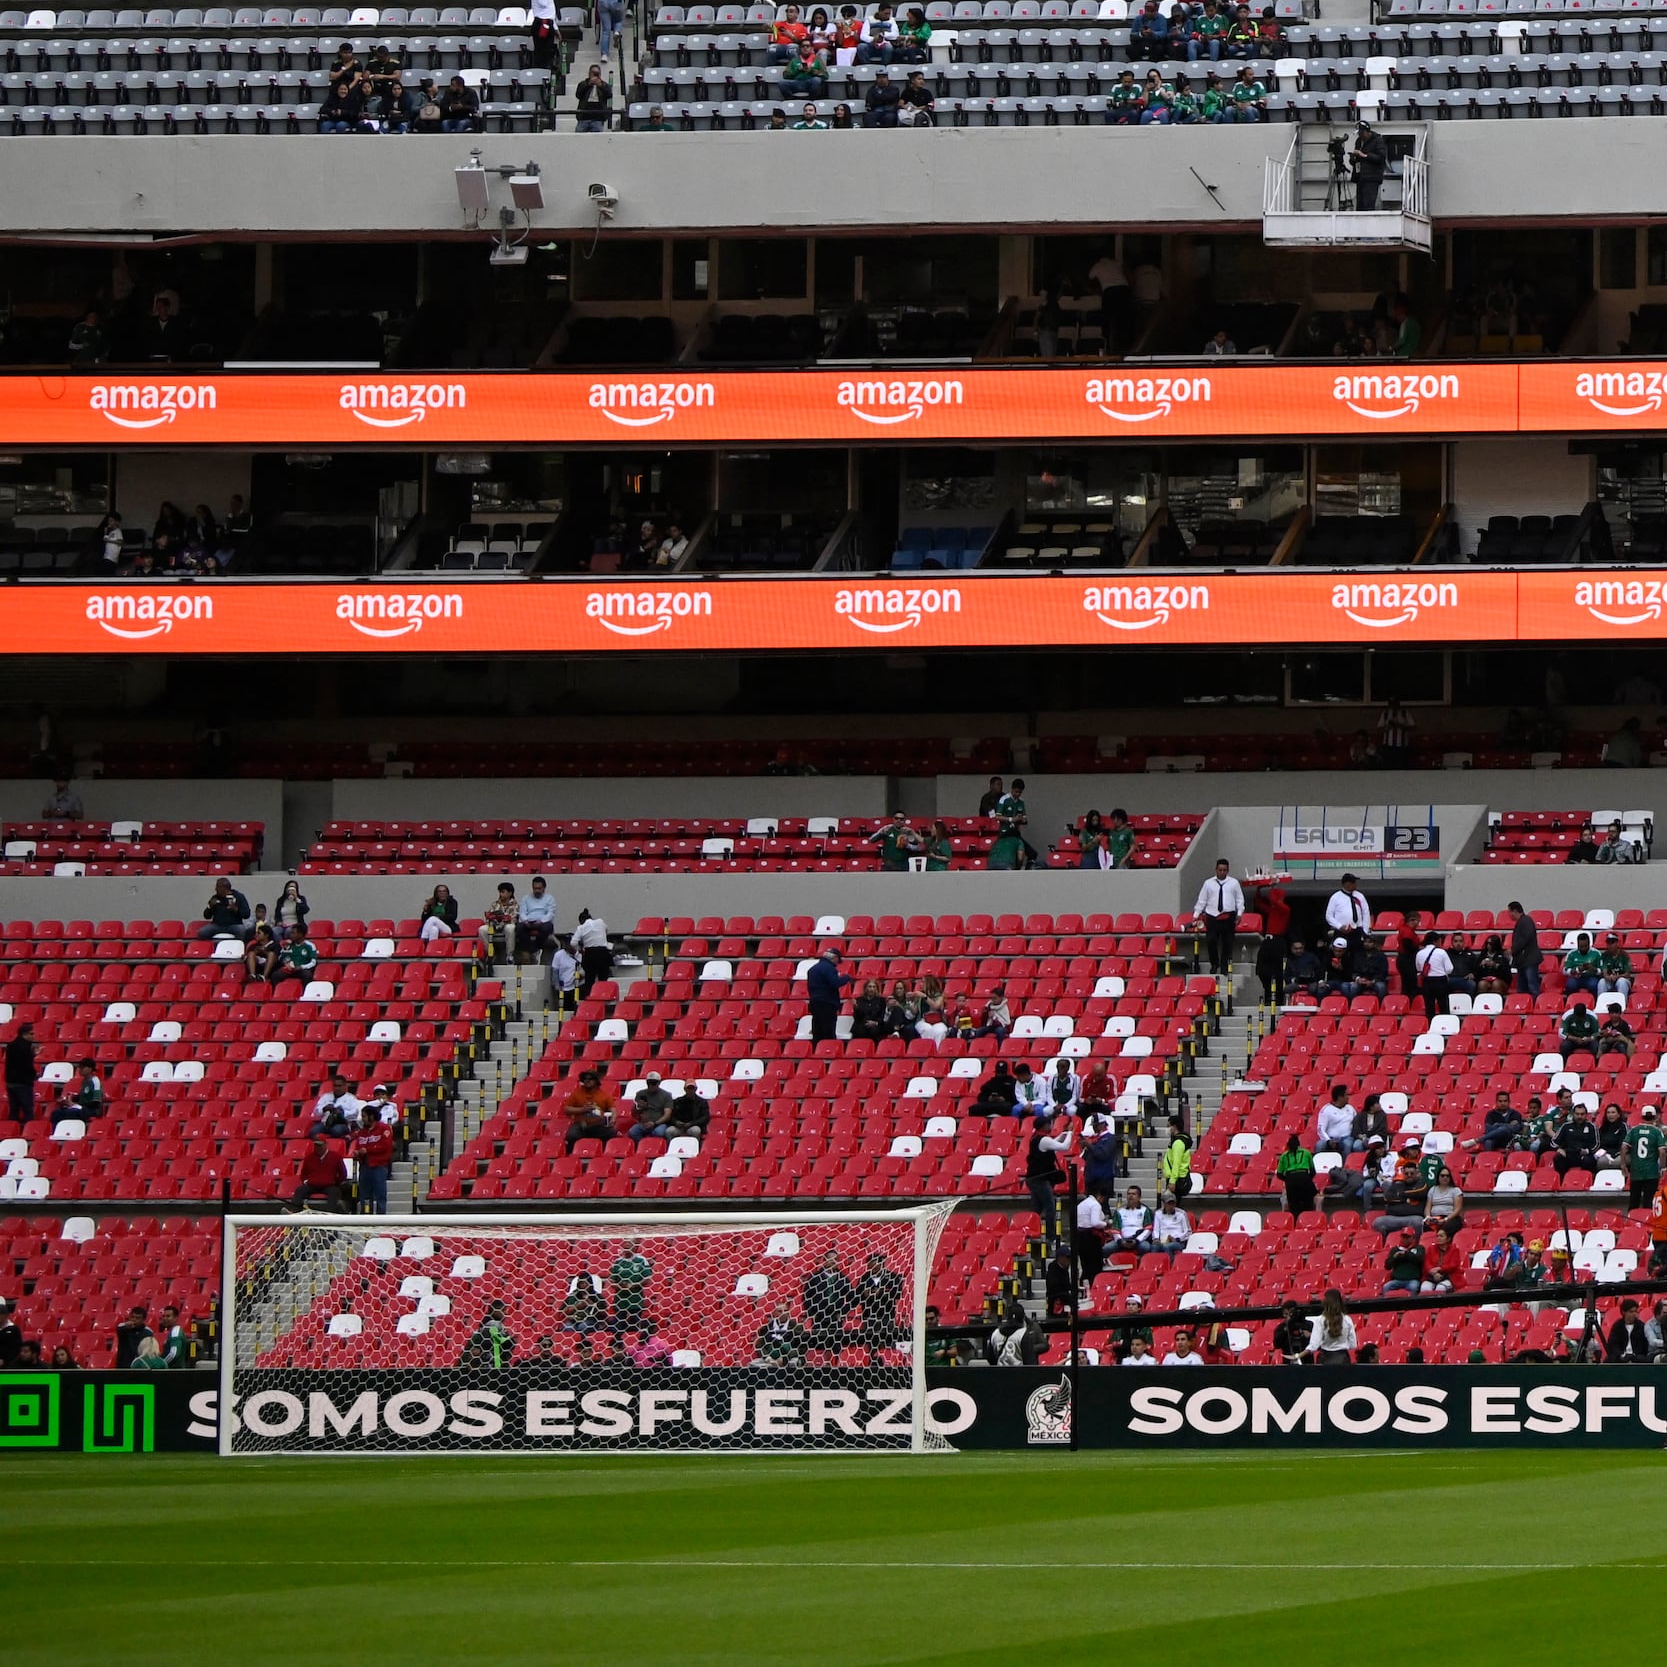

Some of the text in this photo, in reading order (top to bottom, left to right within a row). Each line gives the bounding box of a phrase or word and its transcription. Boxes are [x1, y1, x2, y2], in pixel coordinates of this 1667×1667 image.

[90, 386, 216, 408] amazon
[340, 385, 465, 408] amazon
[589, 383, 714, 407] amazon
[838, 381, 963, 405] amazon
[1086, 378, 1210, 402] amazon
[1333, 375, 1458, 399] amazon
[86, 596, 212, 619] amazon
[336, 595, 462, 618] amazon
[586, 592, 711, 616] amazon
[835, 589, 960, 613] amazon
[1084, 586, 1208, 610] amazon
[1332, 583, 1457, 608] amazon
[1295, 828, 1430, 850] SALIDA 23
[1637, 1137, 1649, 1159] 6
[1428, 1168, 1436, 1180] 5
[186, 1387, 977, 1438] SOMOS ESFUERZO
[1127, 1385, 1448, 1434] SOMOS
[1031, 1430, 1071, 1441] MÉXICO
